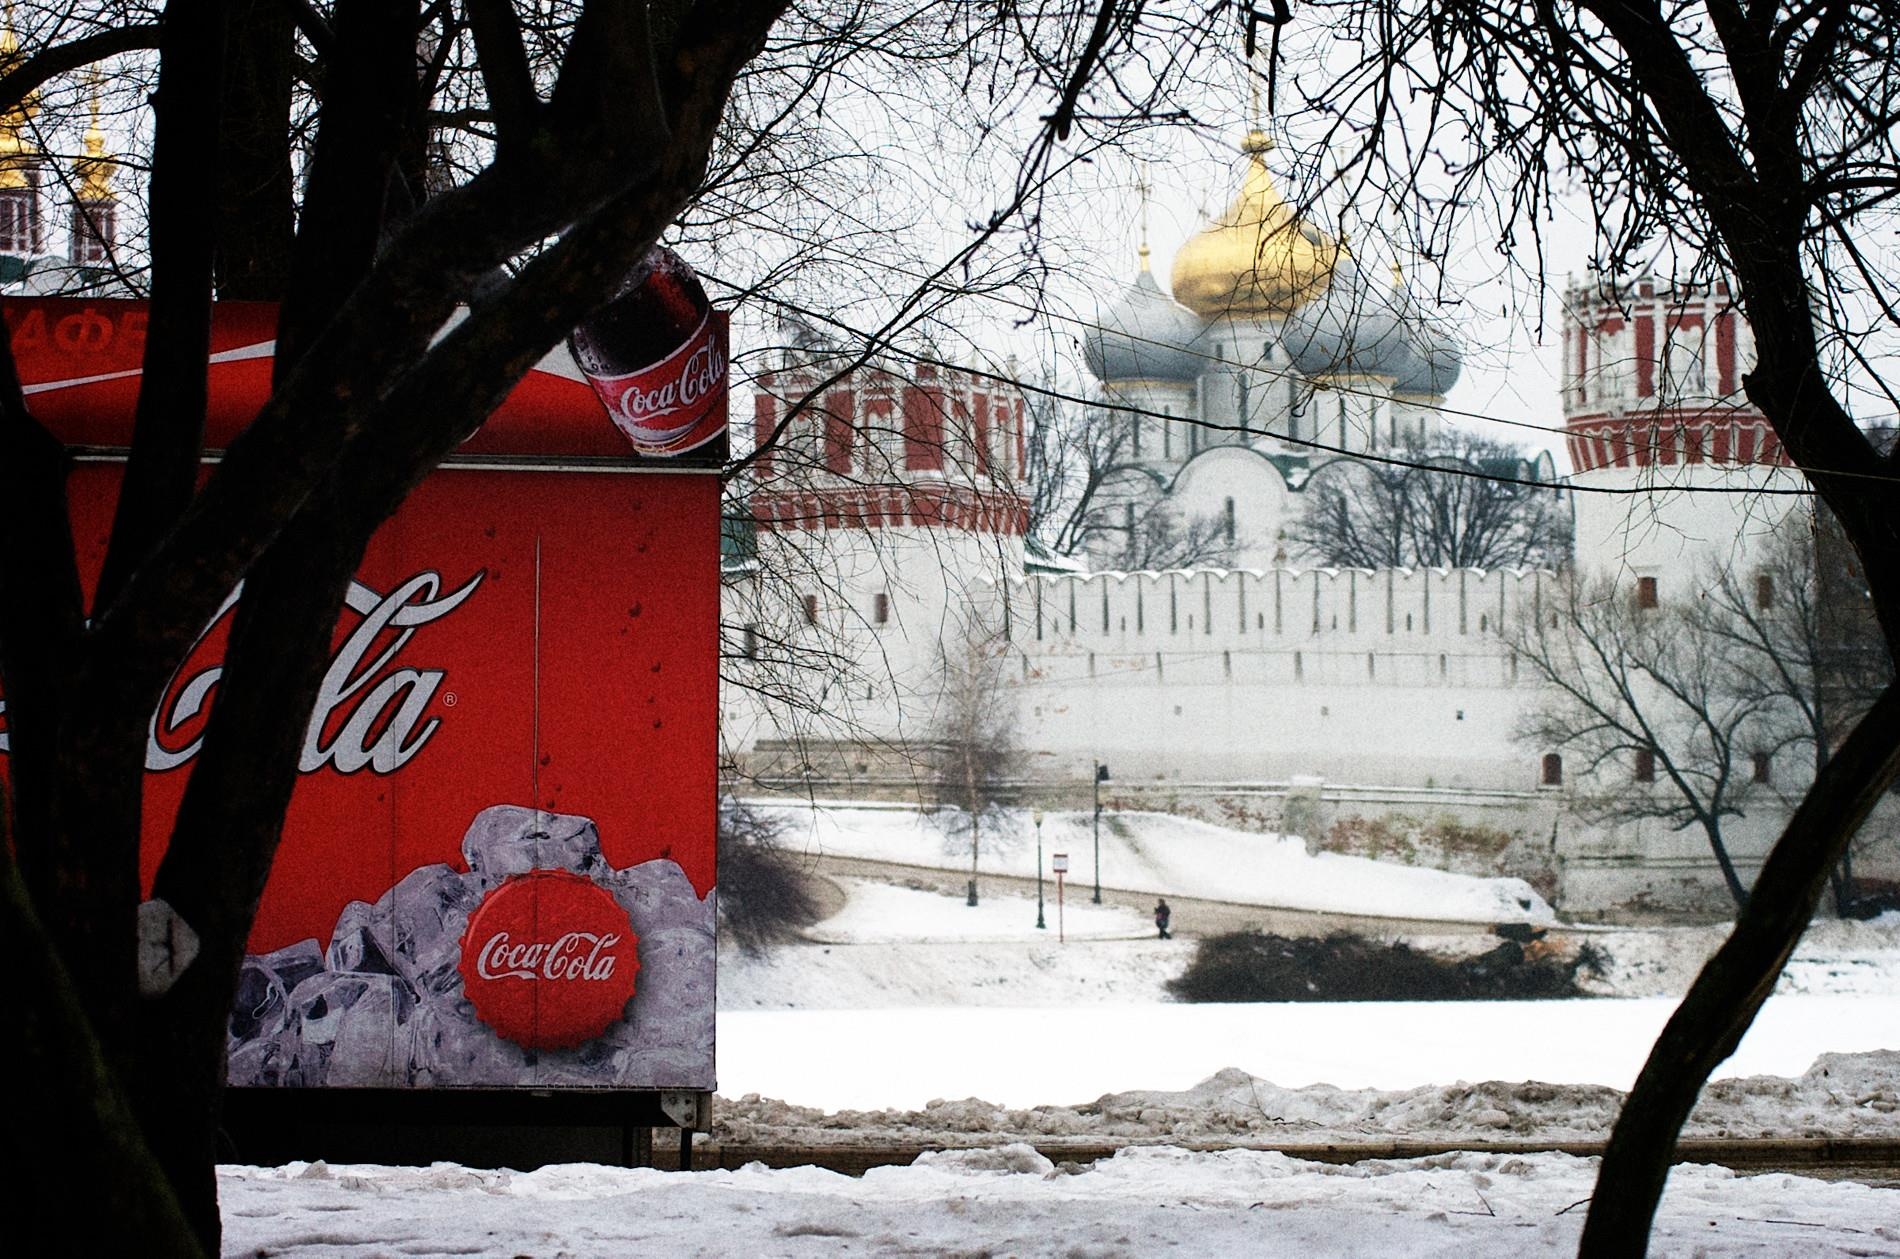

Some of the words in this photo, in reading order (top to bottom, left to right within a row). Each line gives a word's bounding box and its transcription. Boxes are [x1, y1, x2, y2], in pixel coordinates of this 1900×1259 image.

[3, 308, 149, 353] АФЕ
[620, 335, 725, 422] Coca-Cola
[476, 931, 622, 981] Coca-Cola
